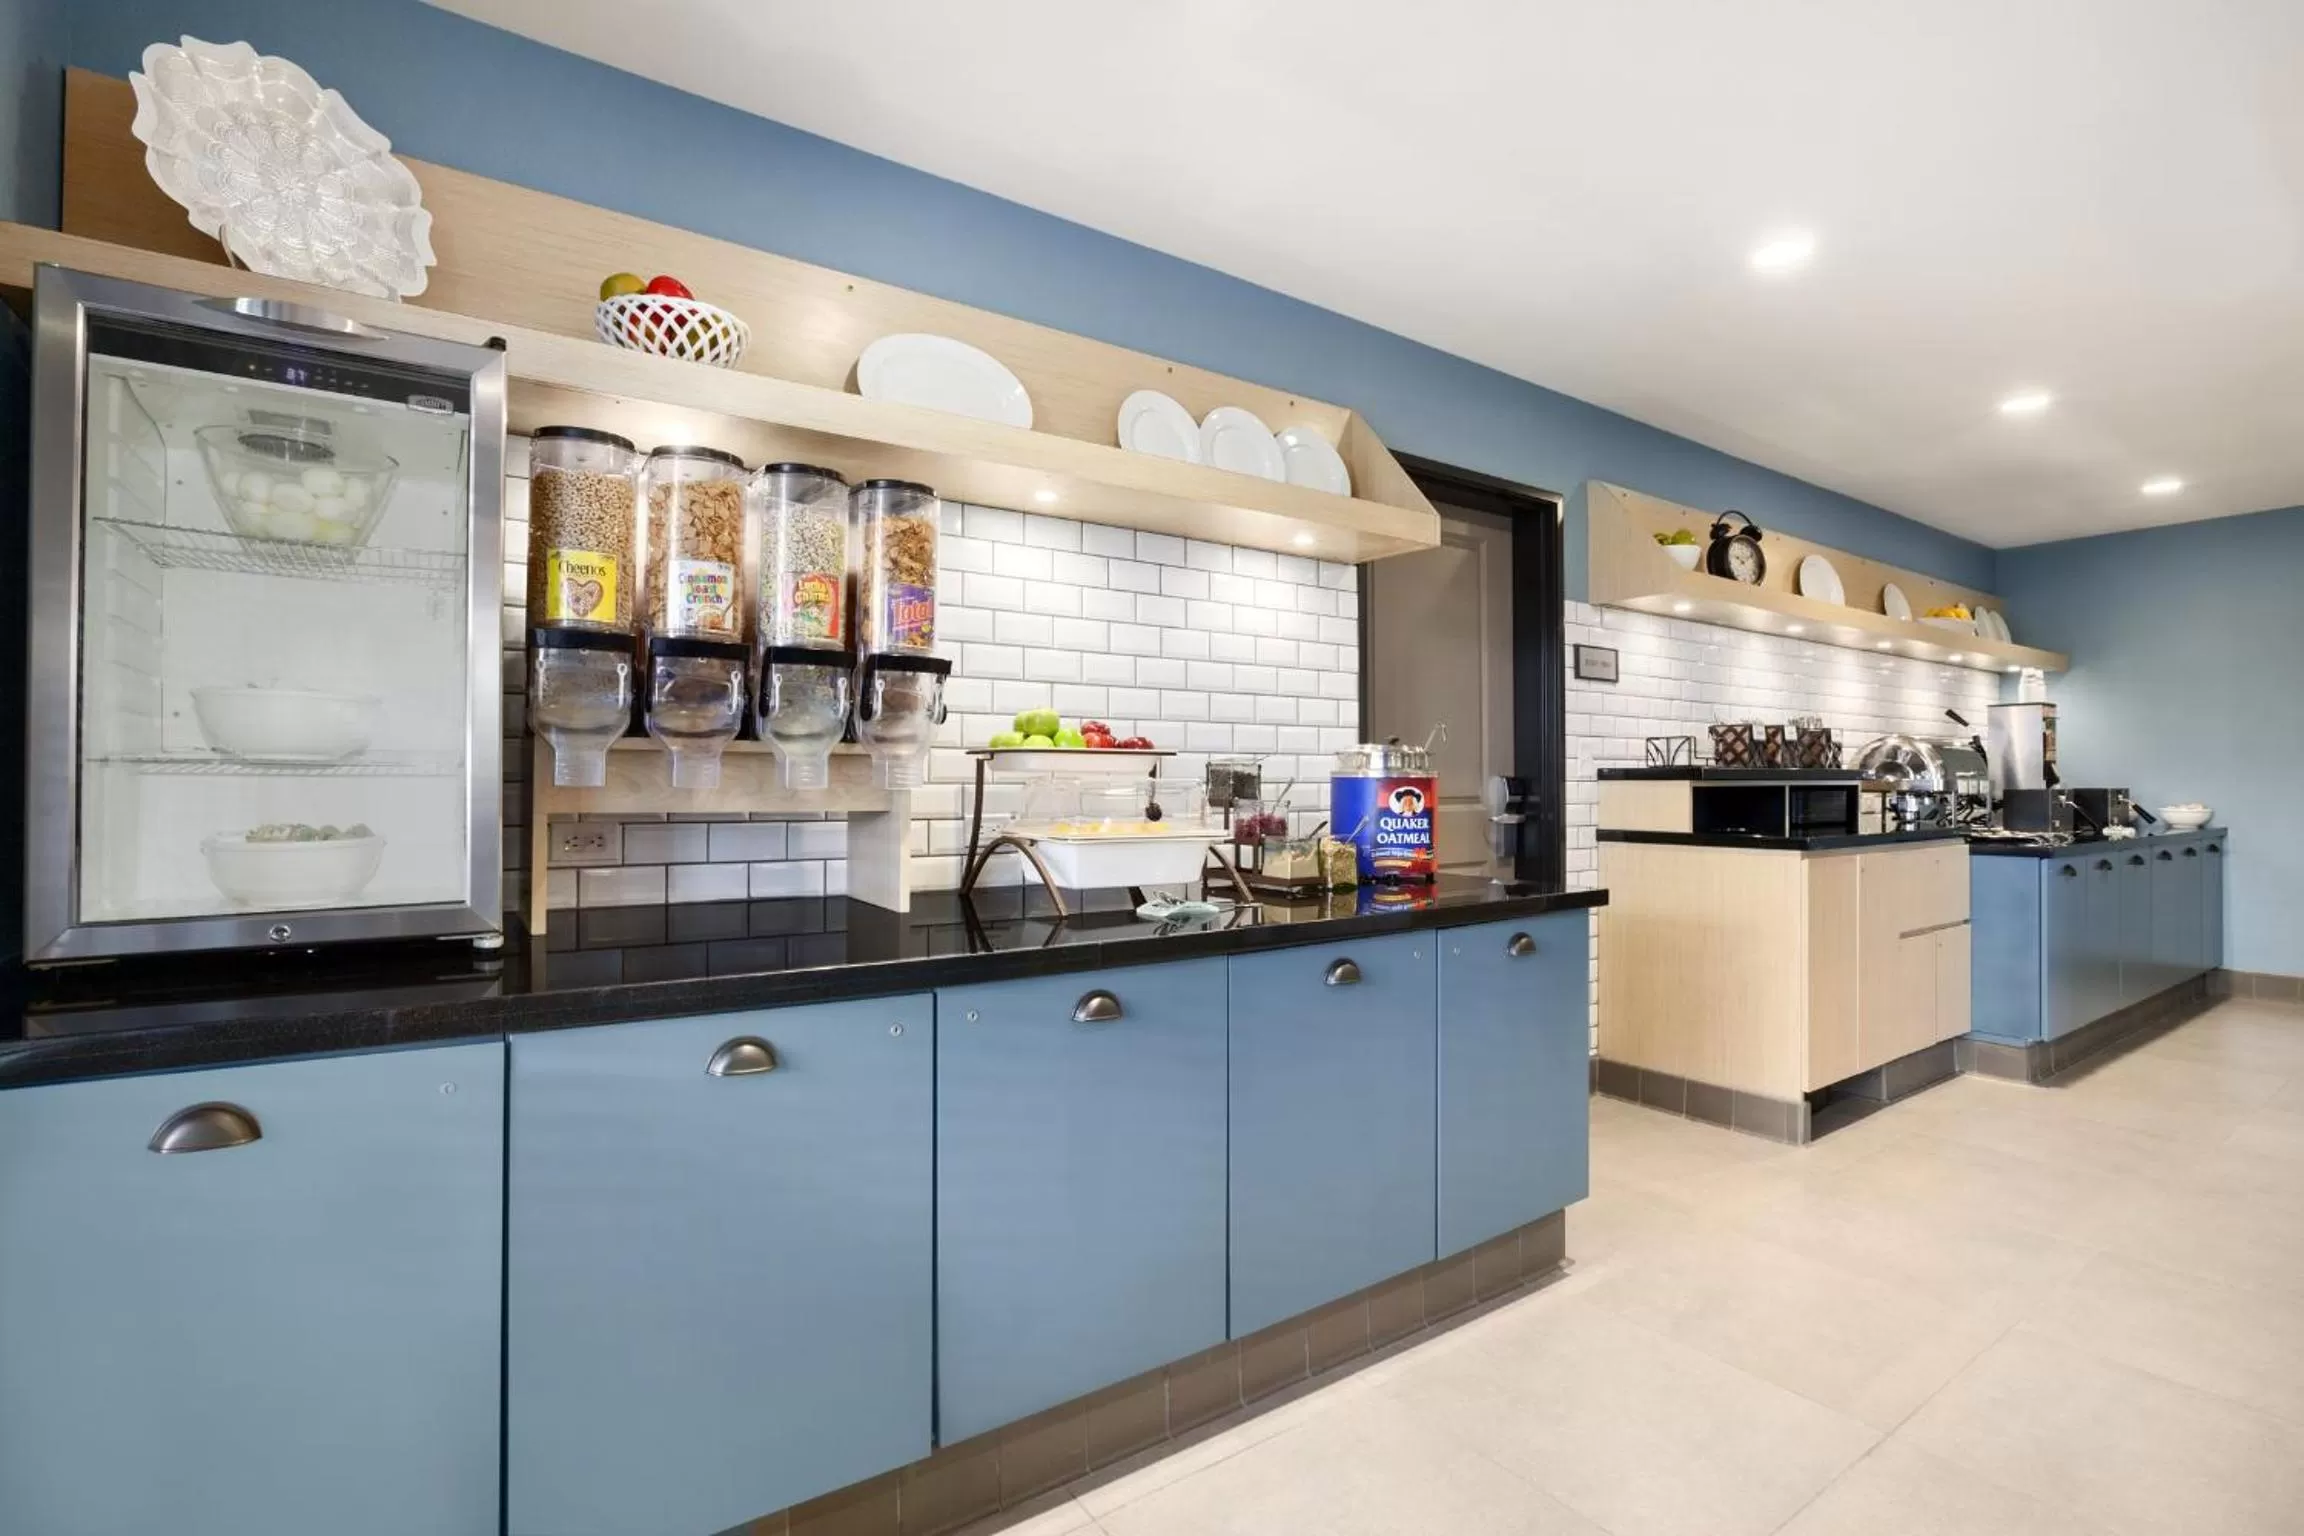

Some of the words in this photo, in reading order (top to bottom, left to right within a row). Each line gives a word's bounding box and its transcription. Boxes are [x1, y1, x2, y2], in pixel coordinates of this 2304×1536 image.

[558, 559, 606, 577] Cheerios
[686, 592, 722, 605] Crunch
[890, 598, 934, 626] Total
[1379, 816, 1429, 832] QUAKER
[1376, 832, 1430, 845] OATMEAL
